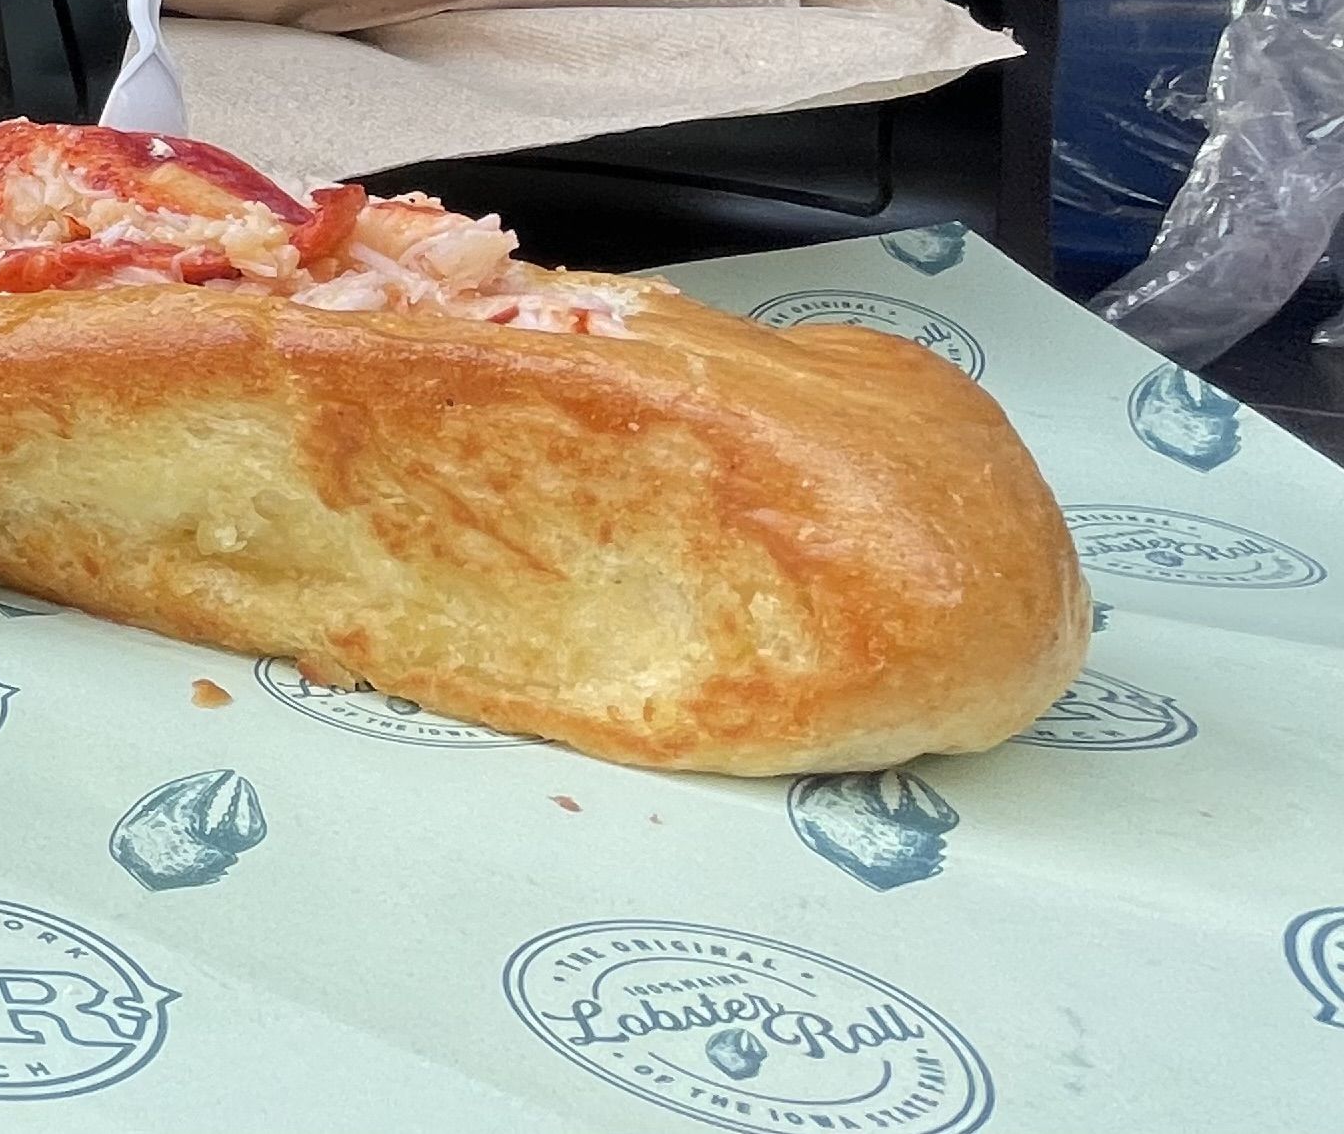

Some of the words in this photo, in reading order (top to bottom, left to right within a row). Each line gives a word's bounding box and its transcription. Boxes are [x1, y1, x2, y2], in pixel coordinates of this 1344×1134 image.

[790, 300, 877, 314] ORIGINAL
[366, 716, 407, 732] THE
[554, 947, 606, 972] THE
[611, 939, 777, 971] ORIGINAL
[540, 993, 785, 1046] Lobster
[761, 1003, 925, 1060] Roll
[634, 1064, 675, 1084] OF
[690, 1086, 751, 1116] THE
[769, 1107, 862, 1130] IOWA
